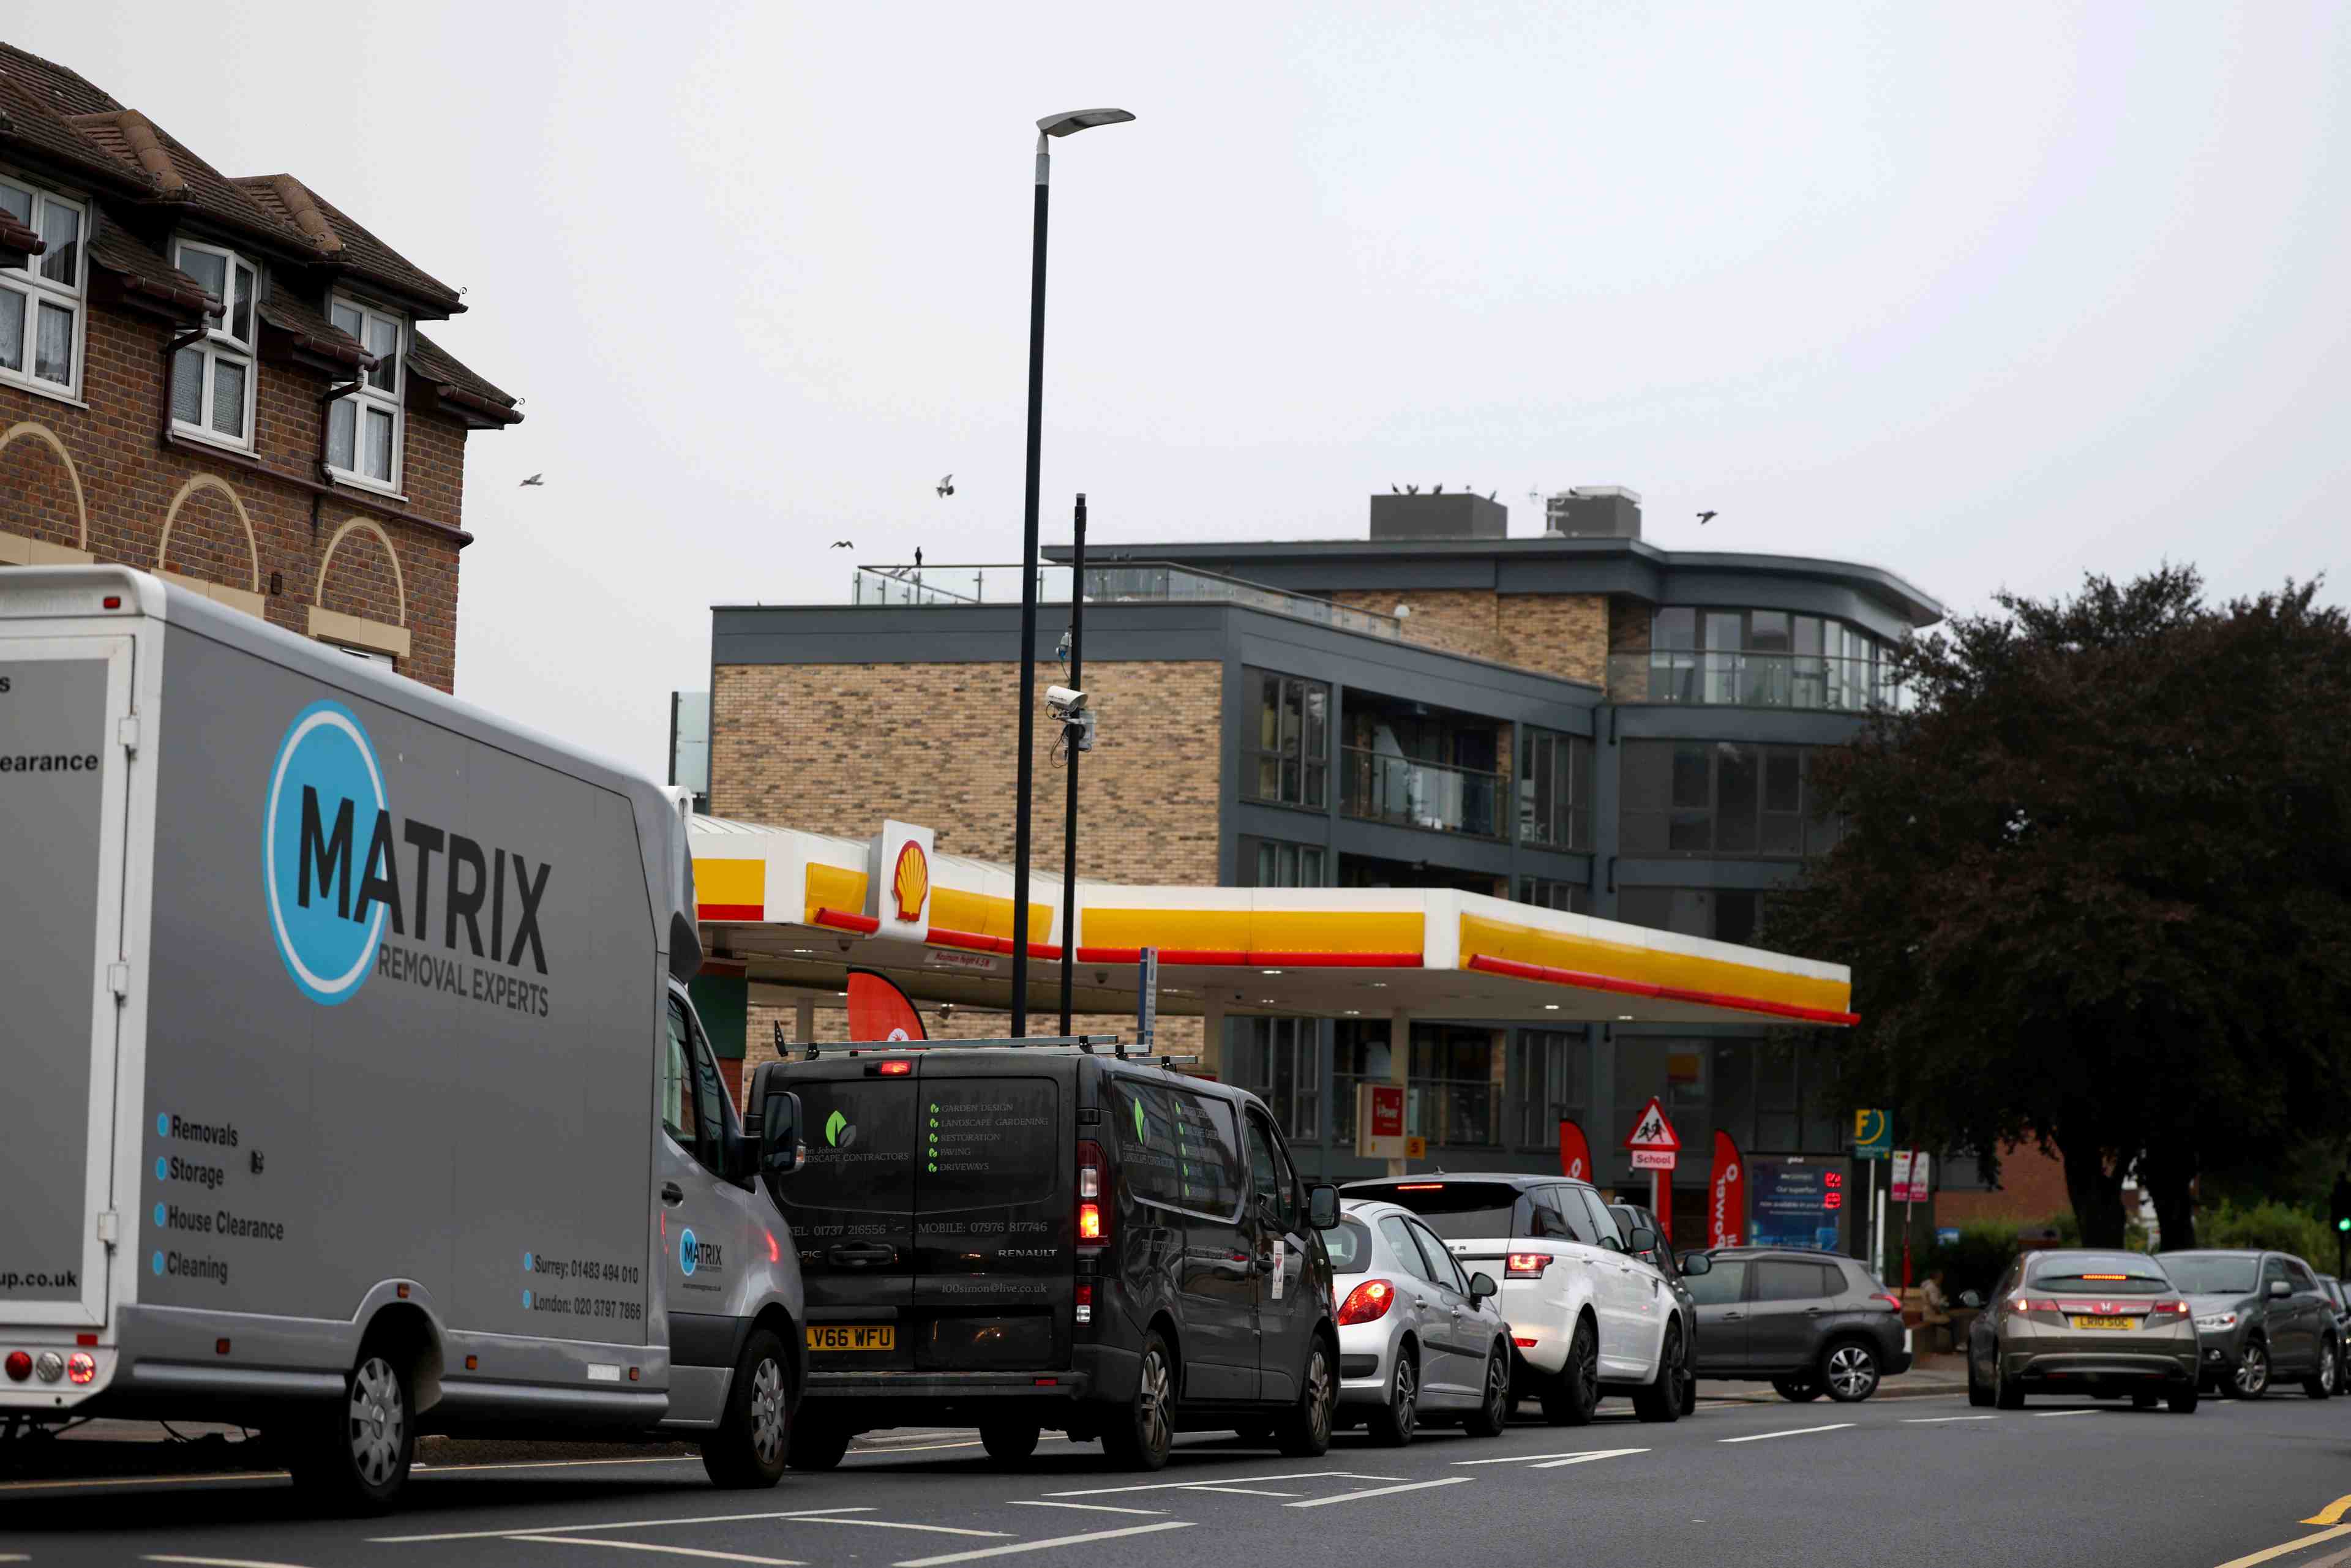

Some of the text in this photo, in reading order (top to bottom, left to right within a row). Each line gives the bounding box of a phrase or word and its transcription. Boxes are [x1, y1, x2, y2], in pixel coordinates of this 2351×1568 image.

[0, 754, 99, 772] earance
[298, 784, 552, 976] MATRIX
[378, 943, 549, 1018] REMOVAL EXPERTS
[942, 1103, 1014, 1112] GARDEN DESIGN
[171, 1114, 239, 1147] Removals
[941, 1117, 1049, 1127] LANDSCAPE GARDENING
[940, 1133, 1001, 1142] RESTORATION
[842, 1152, 910, 1162] CONTRACTORS
[940, 1147, 971, 1156] PAVING
[1637, 1154, 1671, 1164] School
[170, 1156, 224, 1190] Storage
[940, 1163, 990, 1171] DRIVEWAYS
[168, 1204, 284, 1241] House Clearance
[813, 1225, 844, 1236] 01737
[847, 1225, 887, 1235] 216556
[918, 1221, 1048, 1233] MOBILE: 07976 817746
[684, 1241, 722, 1266] MATRIX
[167, 1251, 228, 1286] Cleaning
[534, 1255, 639, 1284] Surrey: 01483 494 010
[533, 1291, 571, 1313] London:
[574, 1297, 591, 1316] 020
[594, 1299, 617, 1318] 3797
[808, 1329, 891, 1347] V66 WFU
